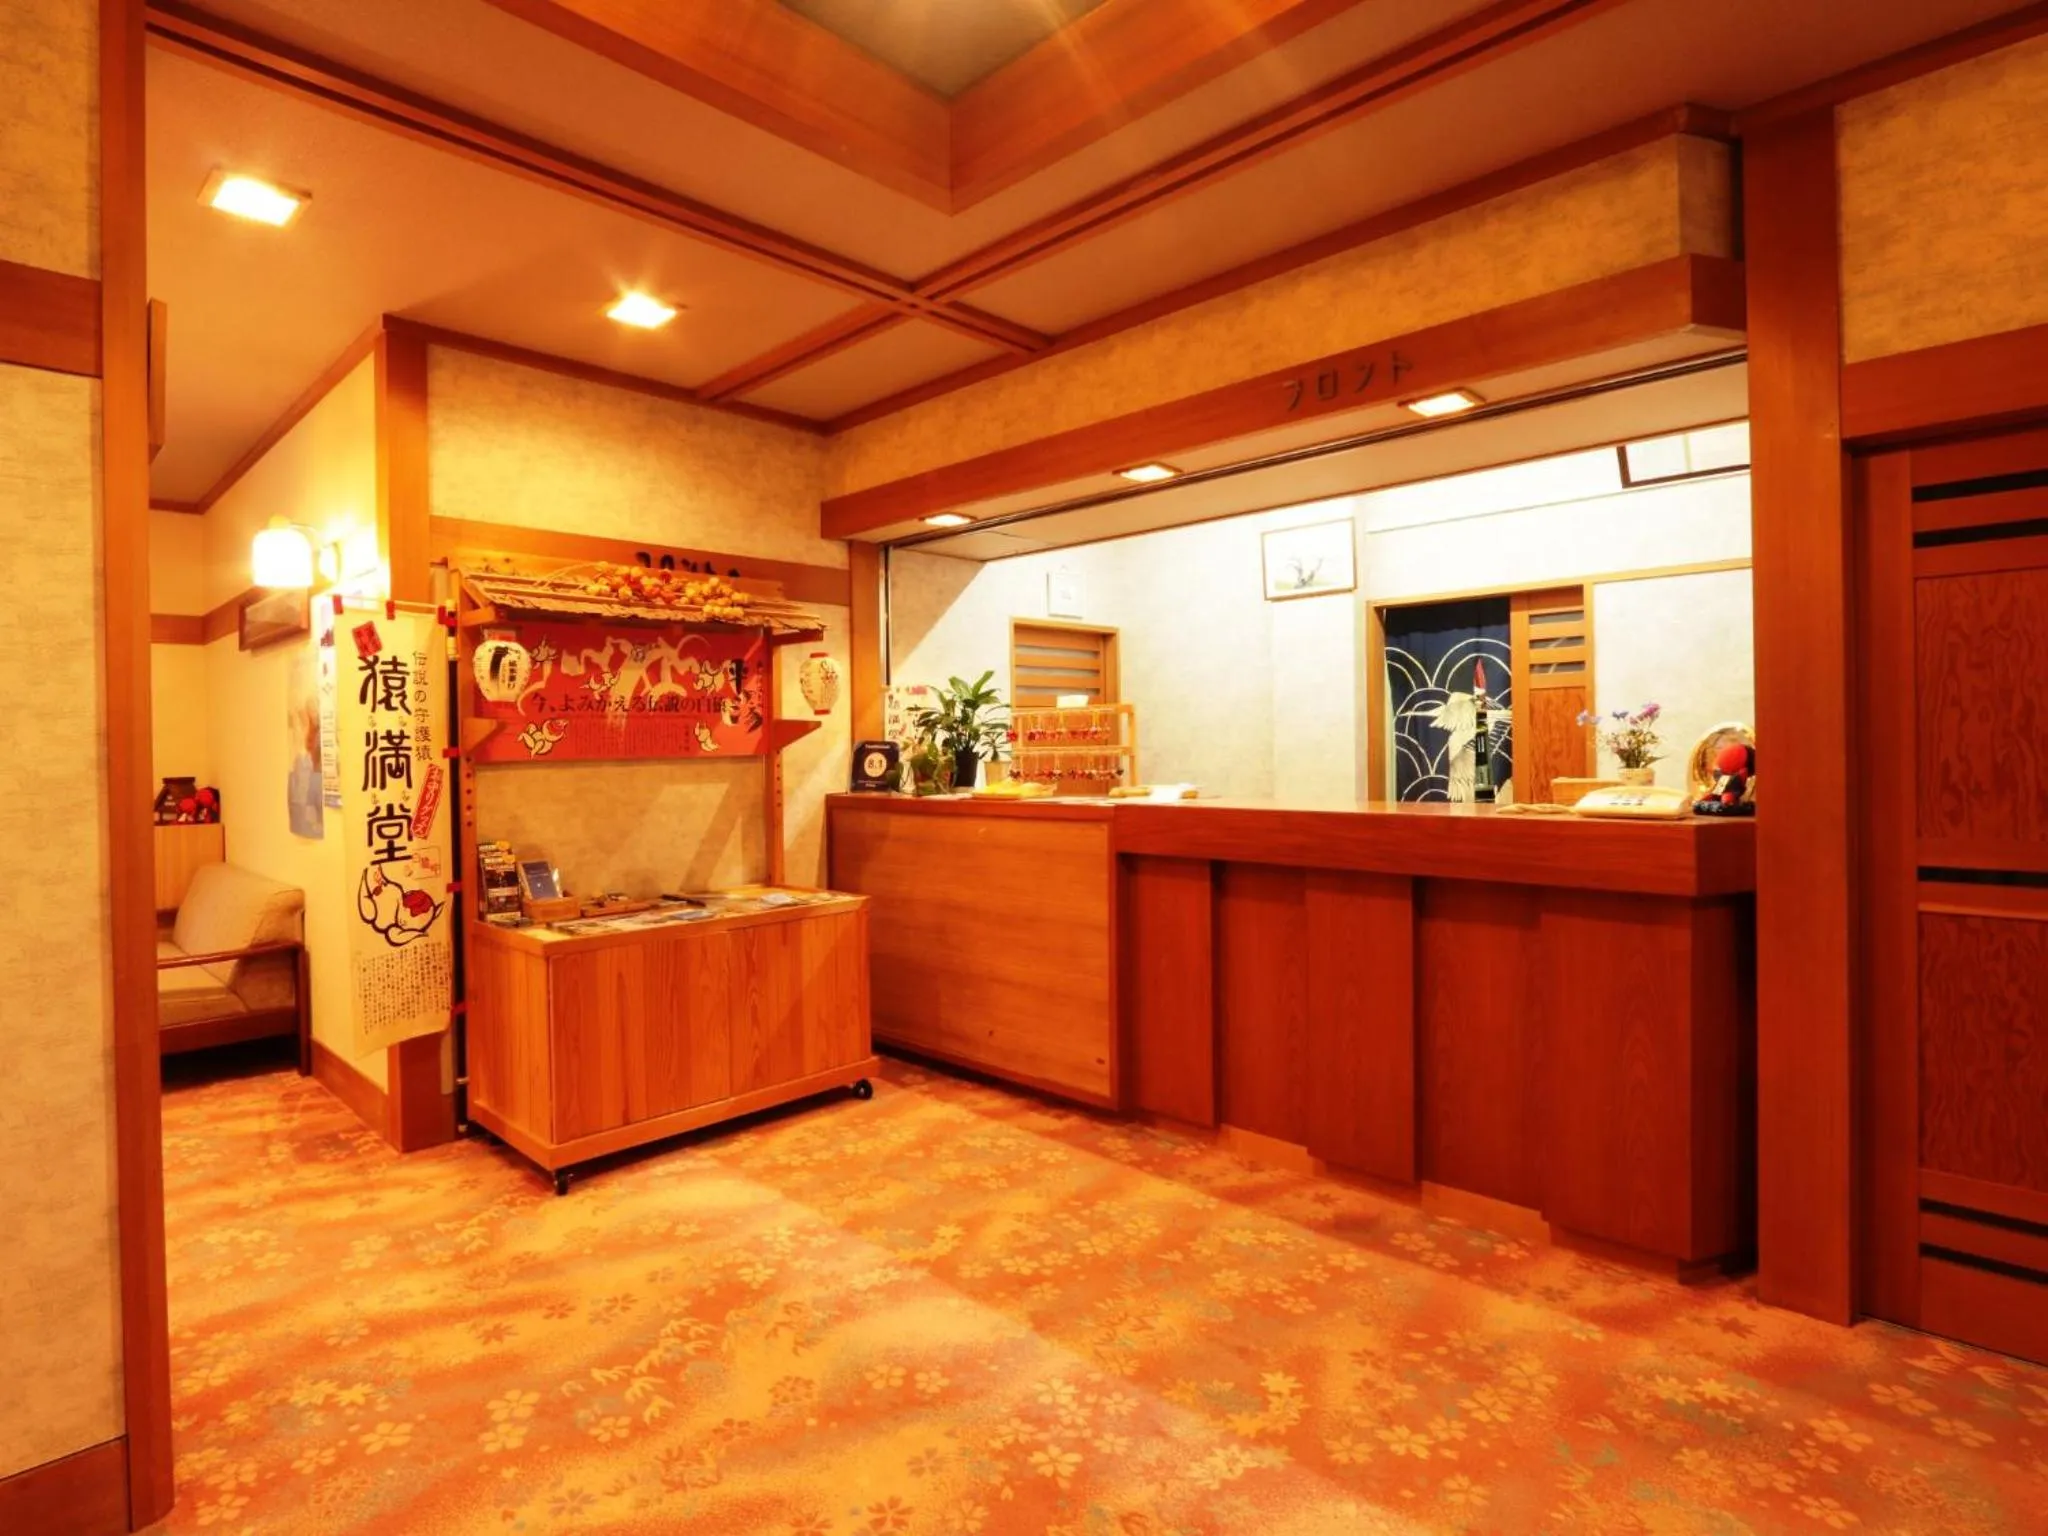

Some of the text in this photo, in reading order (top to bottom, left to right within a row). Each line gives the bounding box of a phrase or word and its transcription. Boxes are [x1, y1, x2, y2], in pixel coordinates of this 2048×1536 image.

[1283, 351, 1413, 412] フロント
[357, 655, 414, 865] 猿満堂
